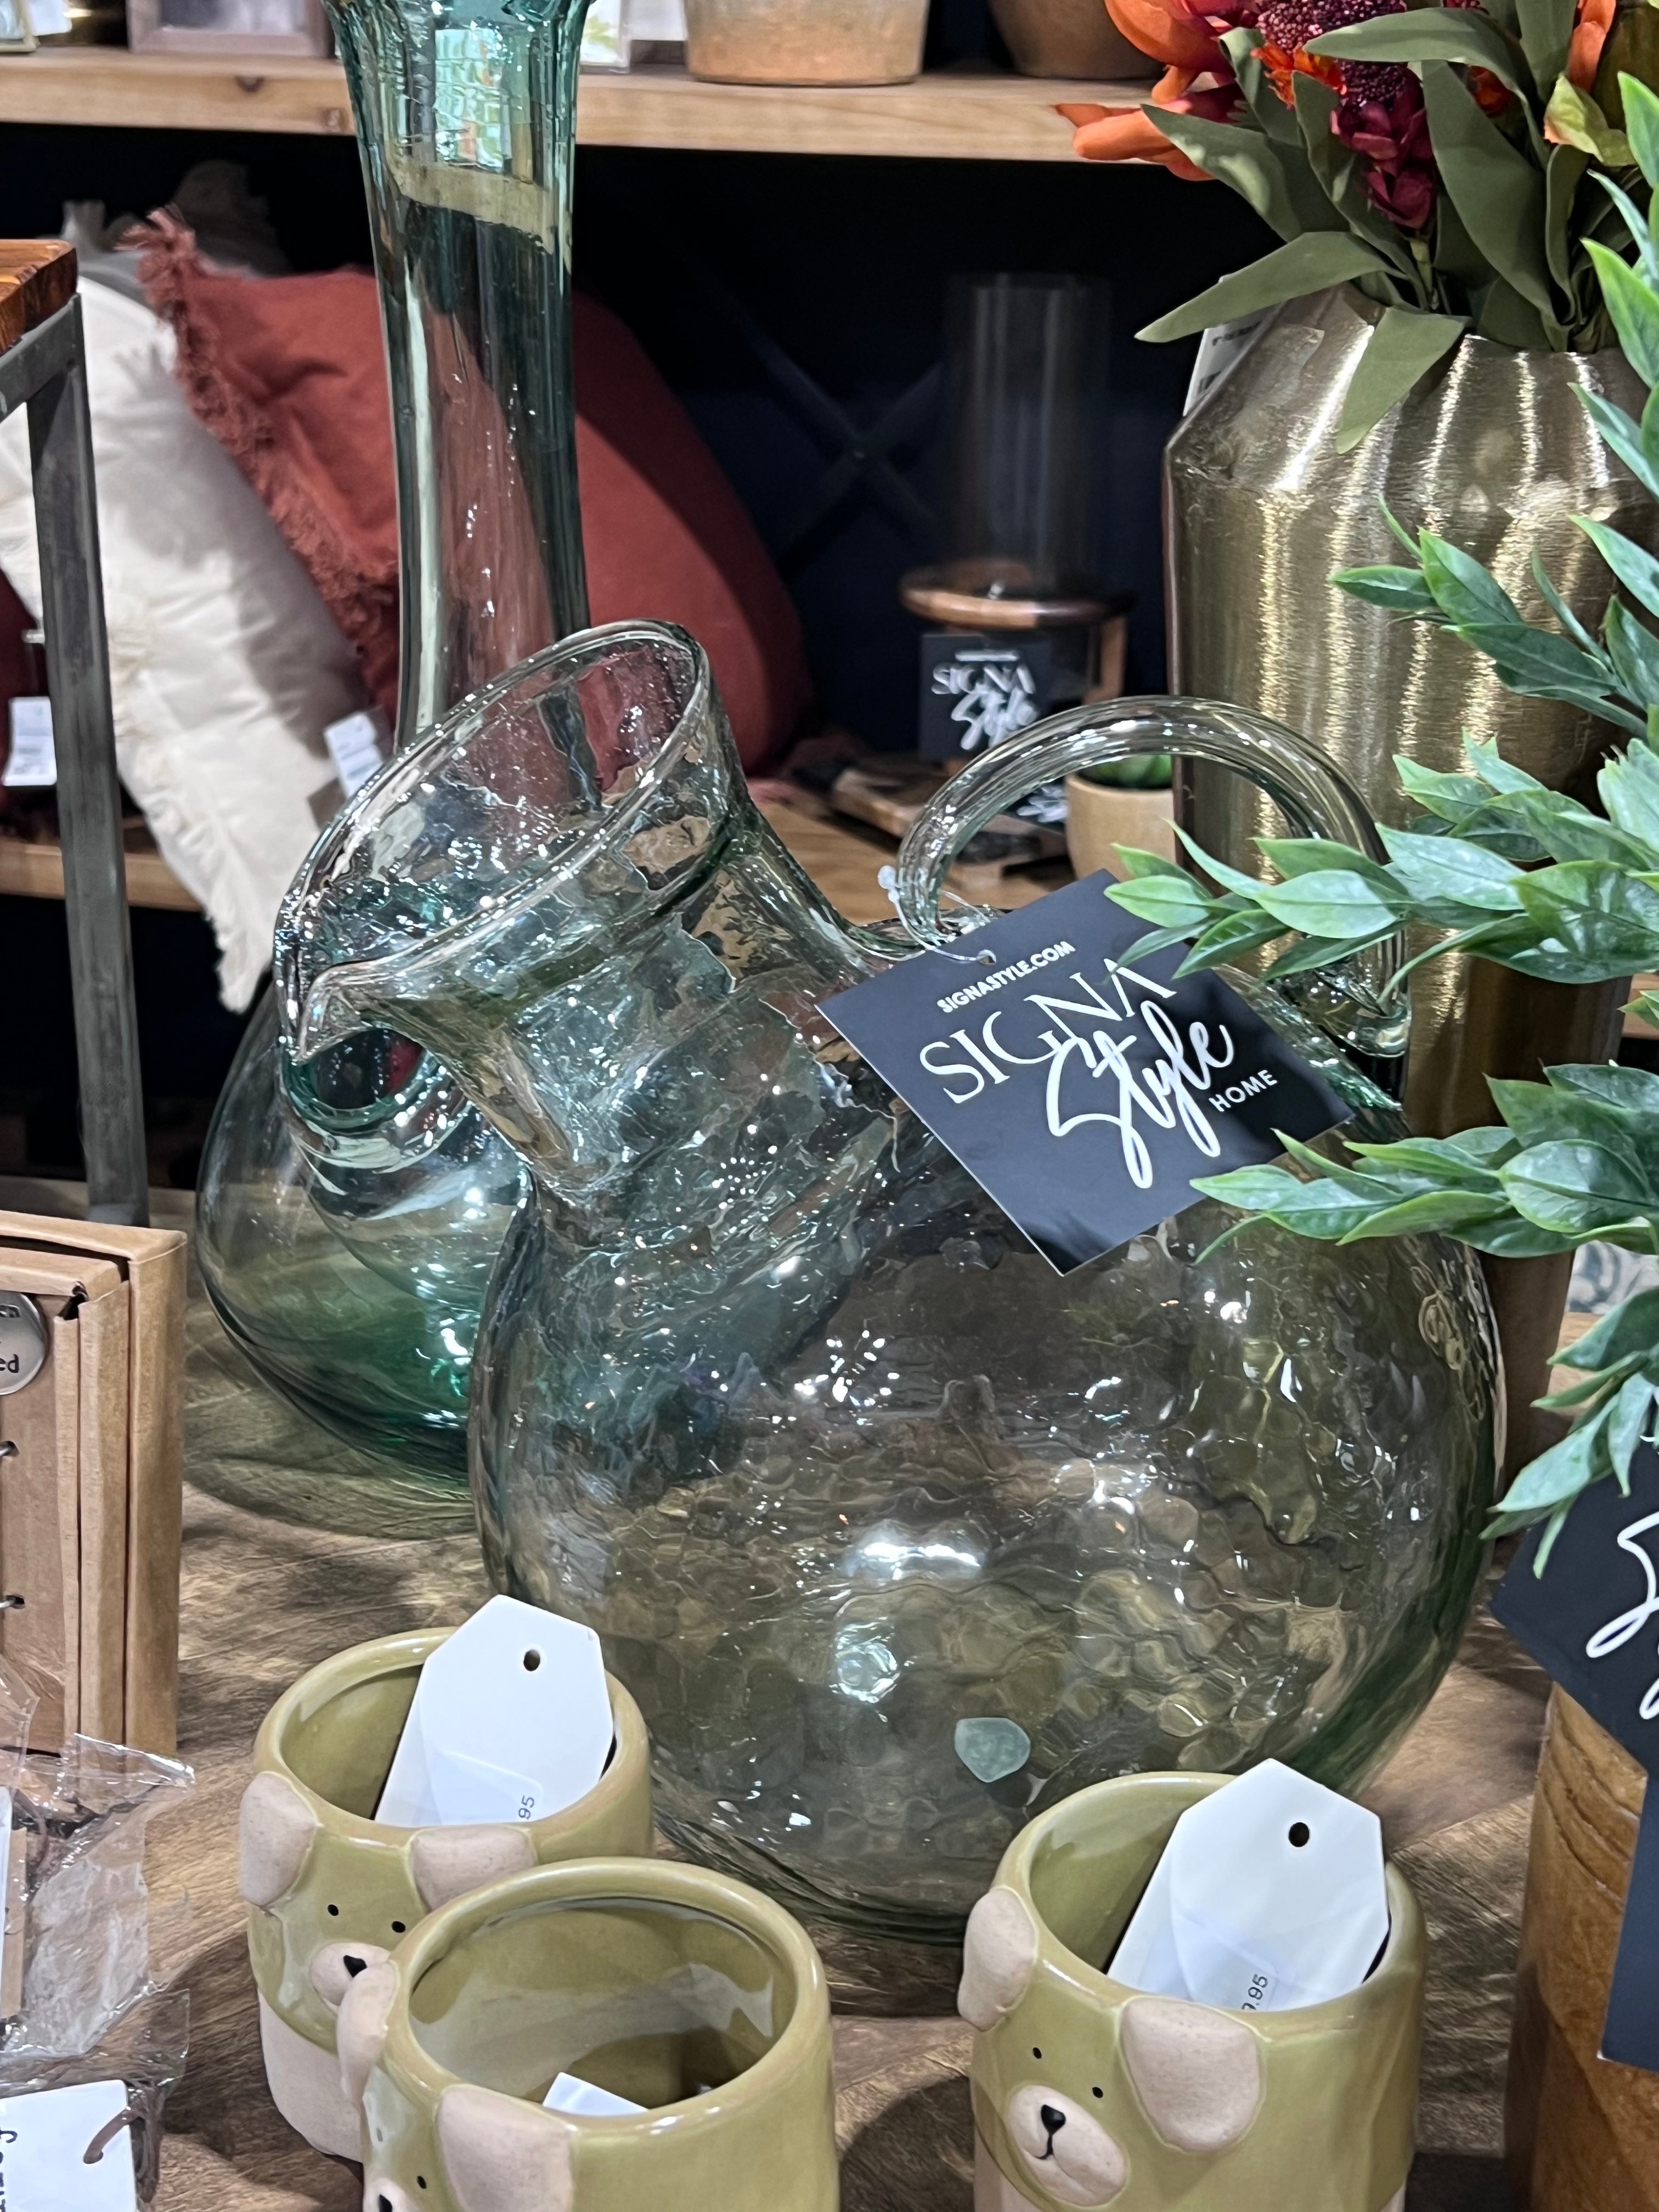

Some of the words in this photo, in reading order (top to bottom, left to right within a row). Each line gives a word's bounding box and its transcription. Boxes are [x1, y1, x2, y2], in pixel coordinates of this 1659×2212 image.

[919, 958, 1177, 1104] SIGNA
[937, 941, 1075, 1013] SIGNASTYLE.COM
[1046, 1000, 1234, 1189] Style
[1209, 1070, 1277, 1112] HOME
